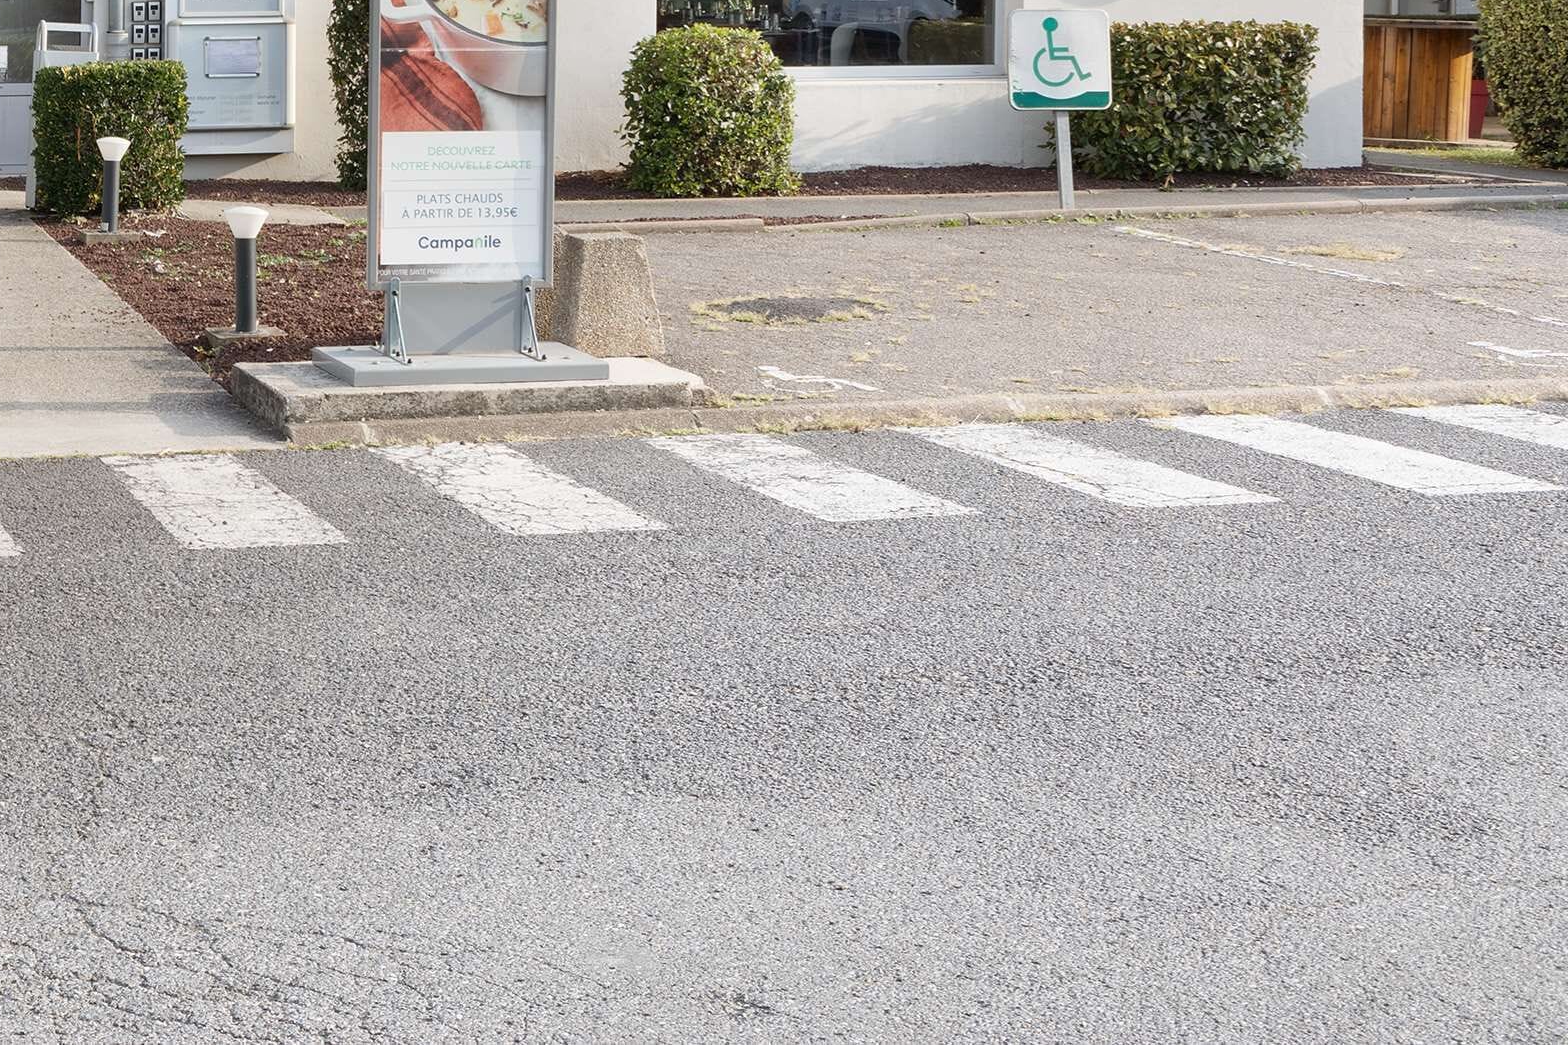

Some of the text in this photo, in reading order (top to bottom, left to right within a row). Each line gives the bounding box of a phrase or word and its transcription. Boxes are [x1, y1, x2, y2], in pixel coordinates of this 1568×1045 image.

[391, 160, 532, 171] NOTRE NOUVELLE CARTE
[417, 193, 503, 204] PLATS CHAUDS
[414, 208, 453, 219] PARTIR
[458, 208, 472, 218] DE
[418, 235, 502, 251] Campanile
